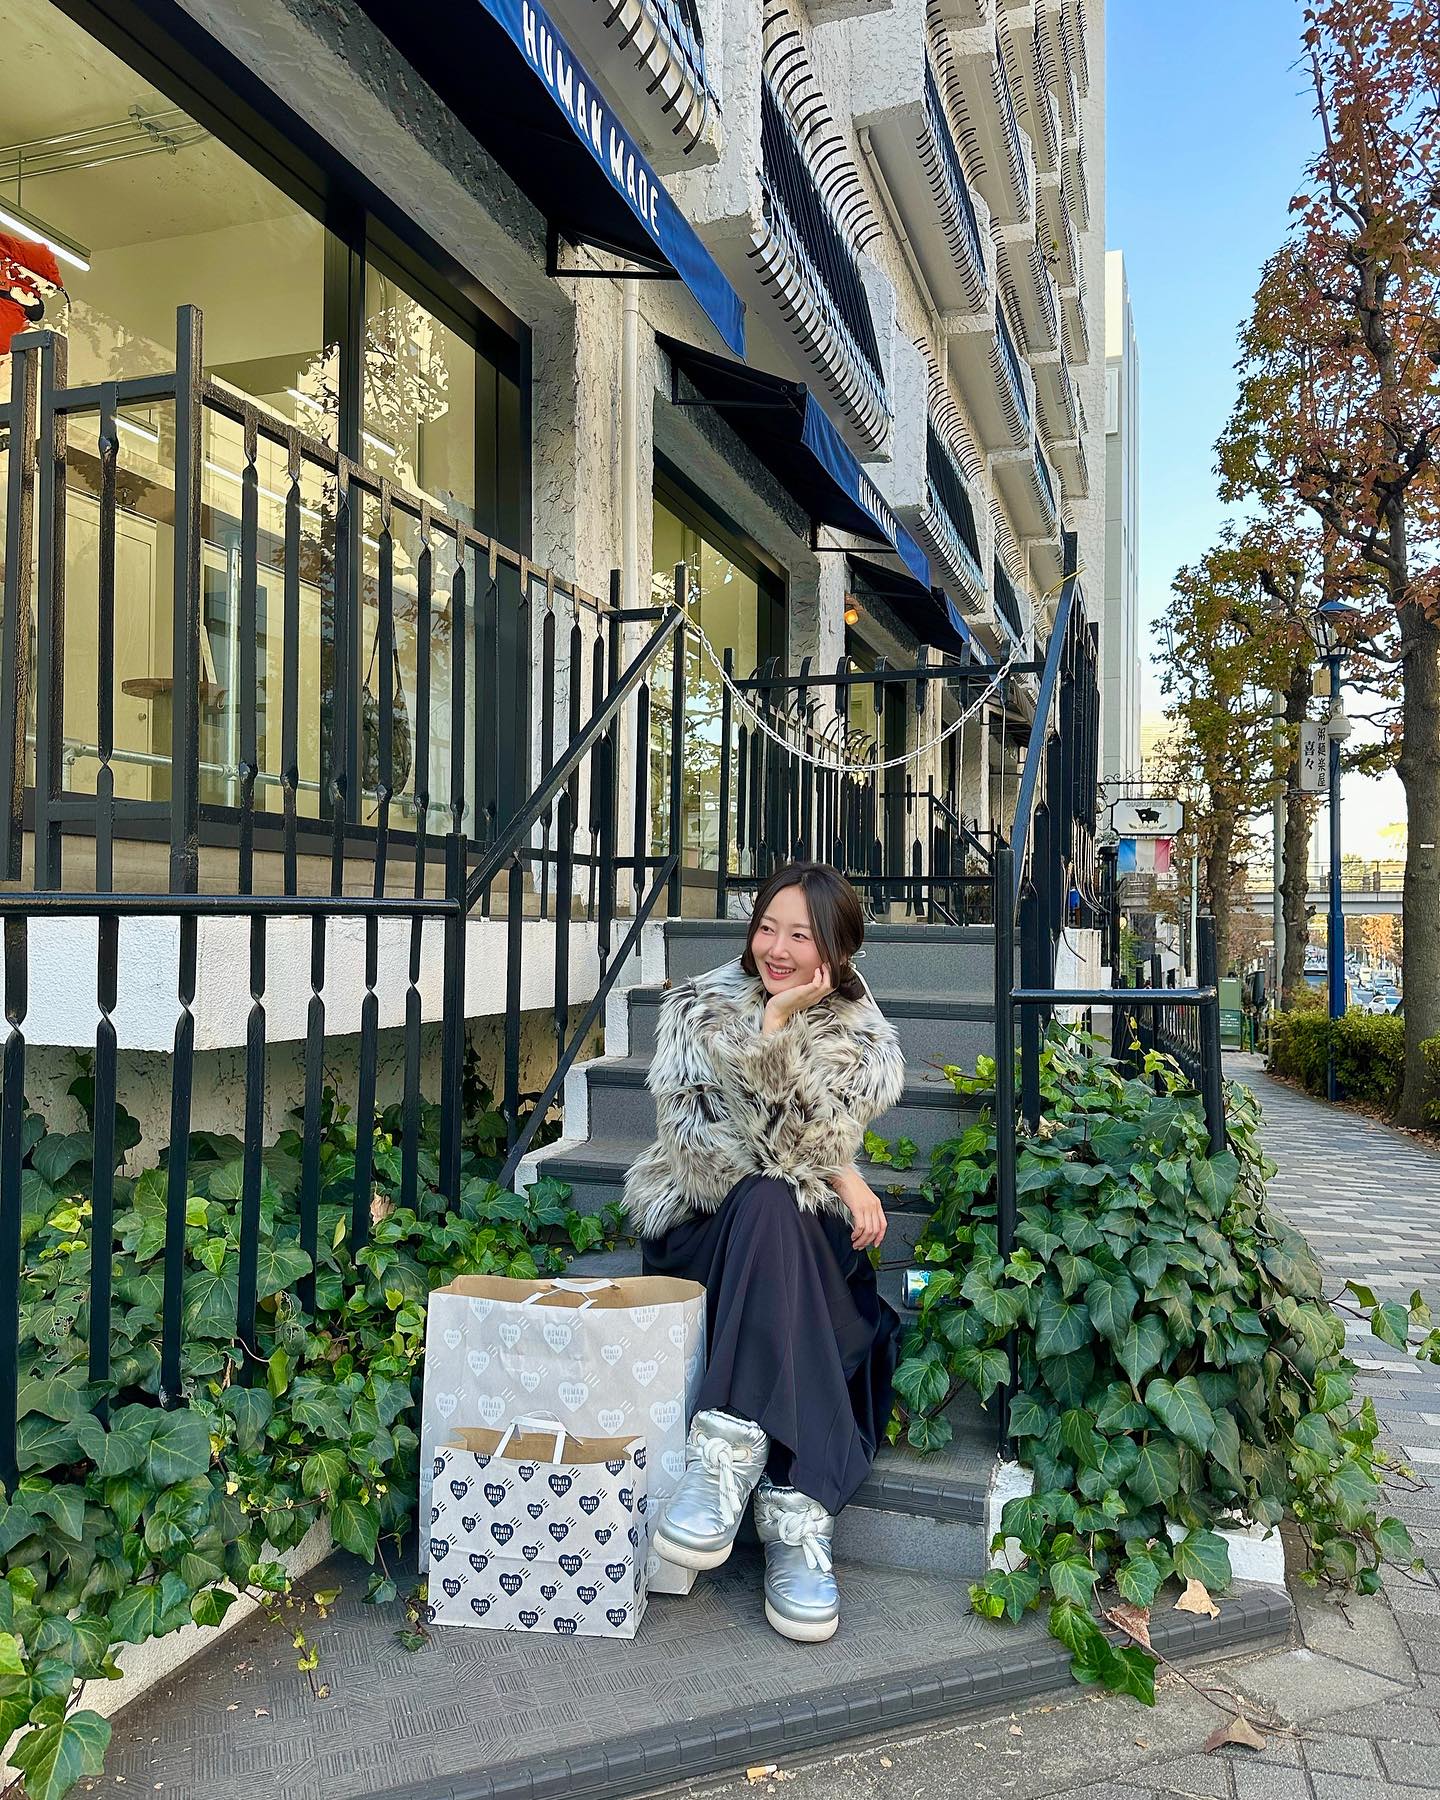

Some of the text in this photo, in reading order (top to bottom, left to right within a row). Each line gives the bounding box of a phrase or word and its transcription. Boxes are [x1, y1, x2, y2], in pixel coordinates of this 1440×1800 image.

[523, 1, 660, 236] HUMAN MADE
[1304, 740, 1315, 770] 喜々
[563, 1387, 584, 1396] HUMAN
[552, 1478, 569, 1486] HUMAN
[487, 1487, 503, 1496] HUMAN
[493, 1526, 511, 1535] HUMAN
[502, 1577, 519, 1585] HUMAN
